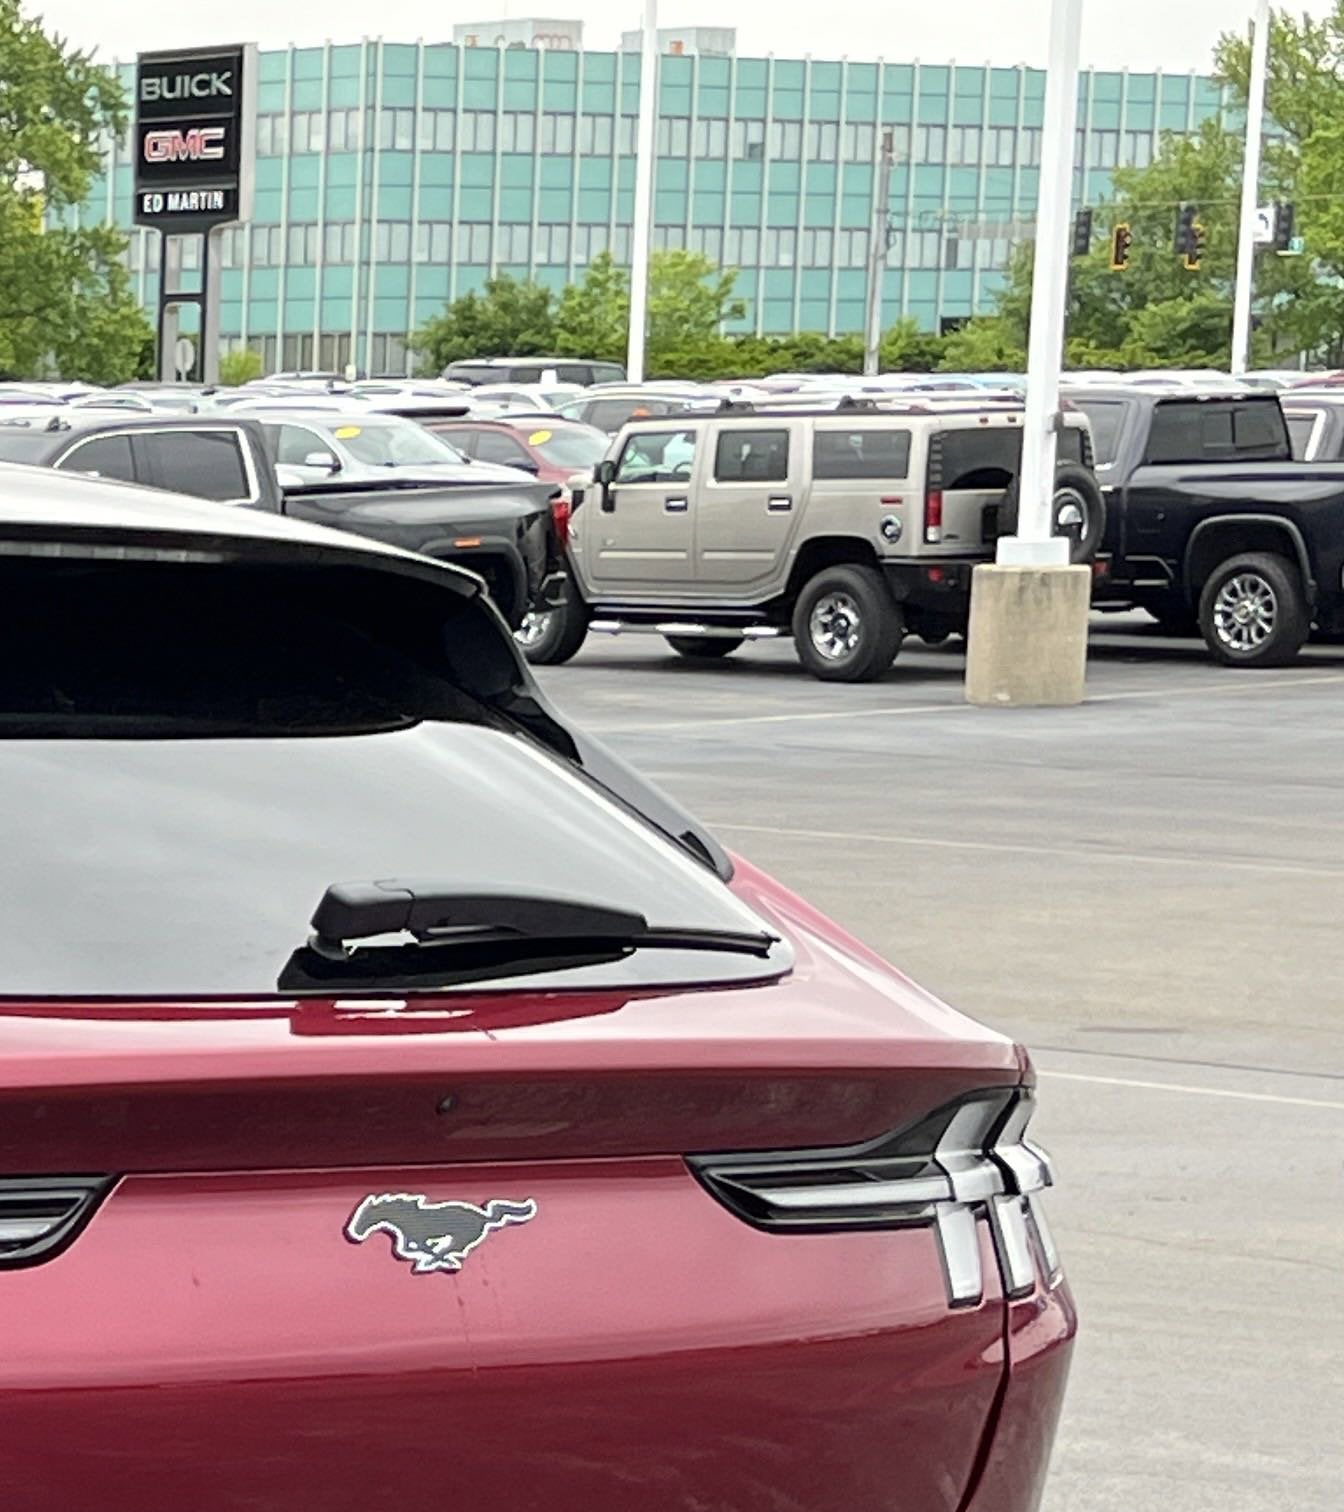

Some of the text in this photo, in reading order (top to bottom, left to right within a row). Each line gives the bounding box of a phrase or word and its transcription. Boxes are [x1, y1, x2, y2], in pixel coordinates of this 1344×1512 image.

[141, 71, 232, 100] BUICK
[144, 126, 225, 162] GMC
[143, 190, 225, 212] ED MARTIN
